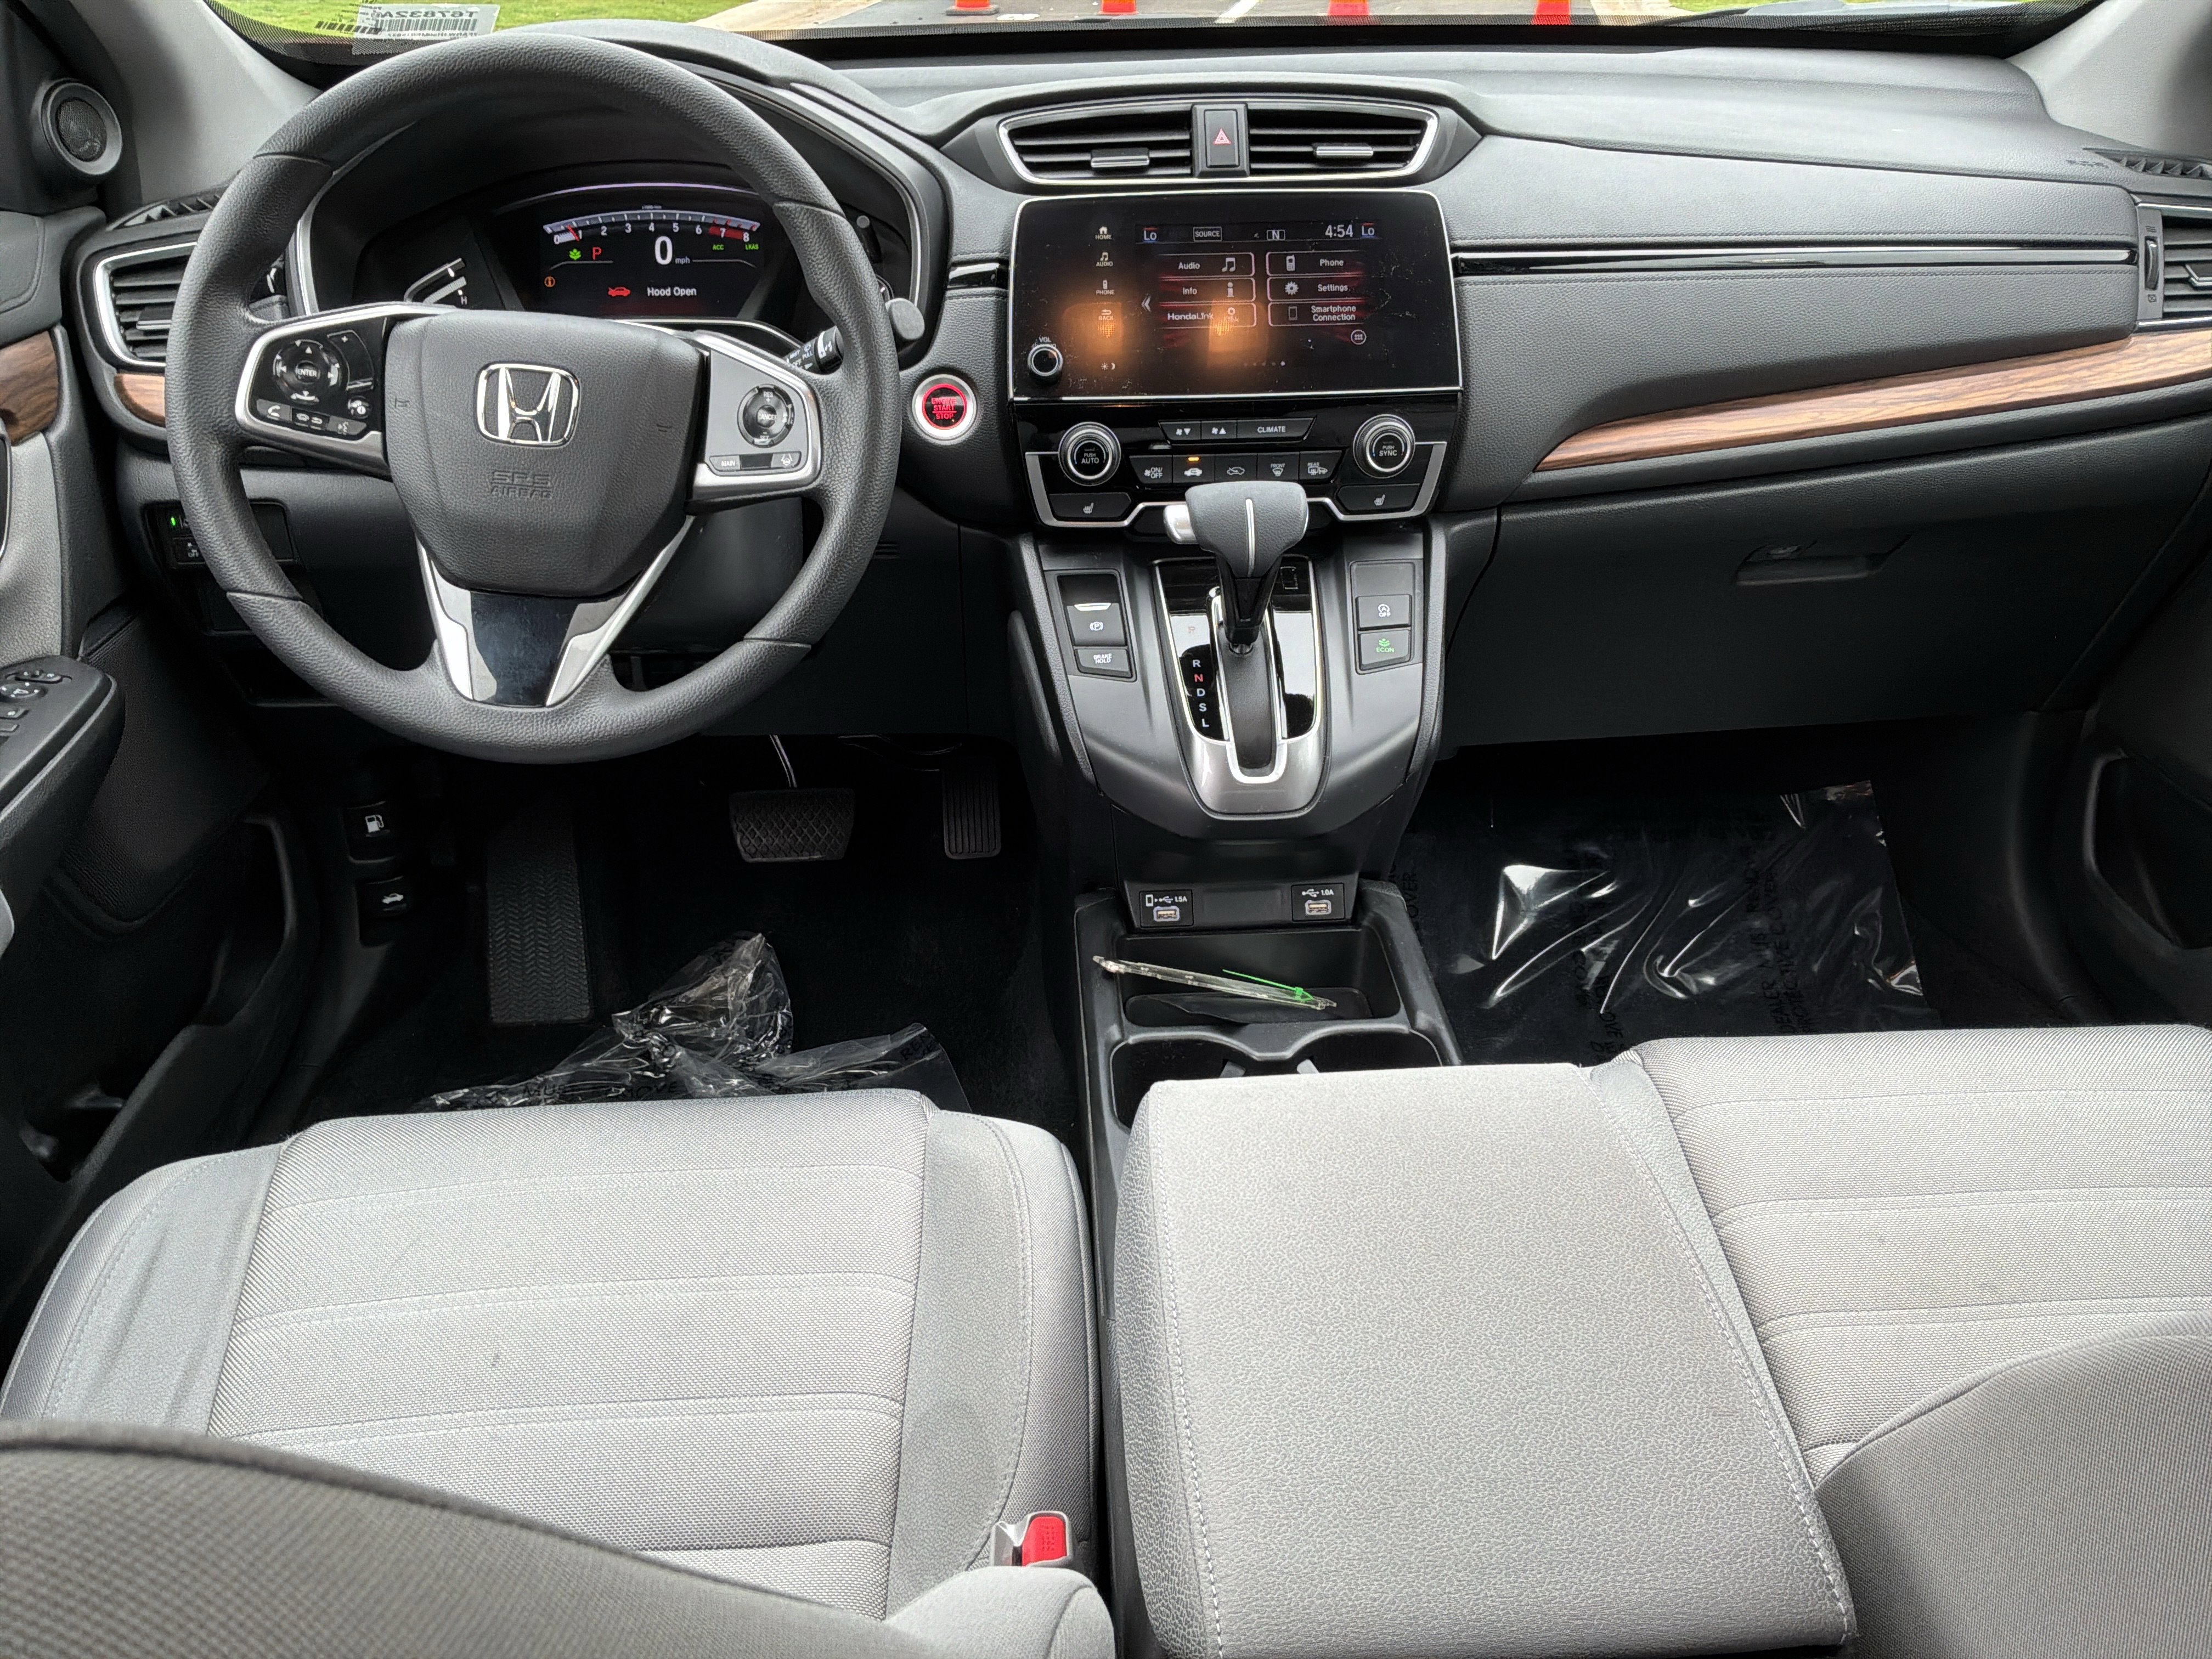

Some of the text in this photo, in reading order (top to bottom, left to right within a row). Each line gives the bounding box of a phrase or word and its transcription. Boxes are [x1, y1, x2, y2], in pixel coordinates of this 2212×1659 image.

[554, 234, 560, 244] 0
[601, 225, 607, 236] 2
[625, 223, 631, 233] 3
[648, 222, 654, 232] 4
[673, 222, 679, 232] 5
[696, 224, 702, 235] 6
[720, 228, 726, 238] 7
[743, 232, 749, 242] 8
[1144, 230, 1156, 240] Lo
[1272, 230, 1279, 240] N
[1325, 224, 1353, 238] 4:54
[1361, 225, 1375, 236] Lo
[592, 247, 602, 260] P
[654, 236, 691, 265] 0 mph
[1178, 262, 1200, 270] Audio
[647, 286, 697, 297] Hood Open
[1183, 287, 1197, 295] Info
[1318, 284, 1348, 292] Settings
[460, 296, 467, 305] H
[1311, 305, 1356, 313] Smartphone
[1167, 312, 1215, 320] HondaLink
[298, 369, 318, 377] ENTER
[1192, 659, 1201, 668] R
[1194, 674, 1203, 682] N
[1197, 688, 1206, 697] D
[1199, 703, 1207, 712] S
[1201, 718, 1210, 727] L
